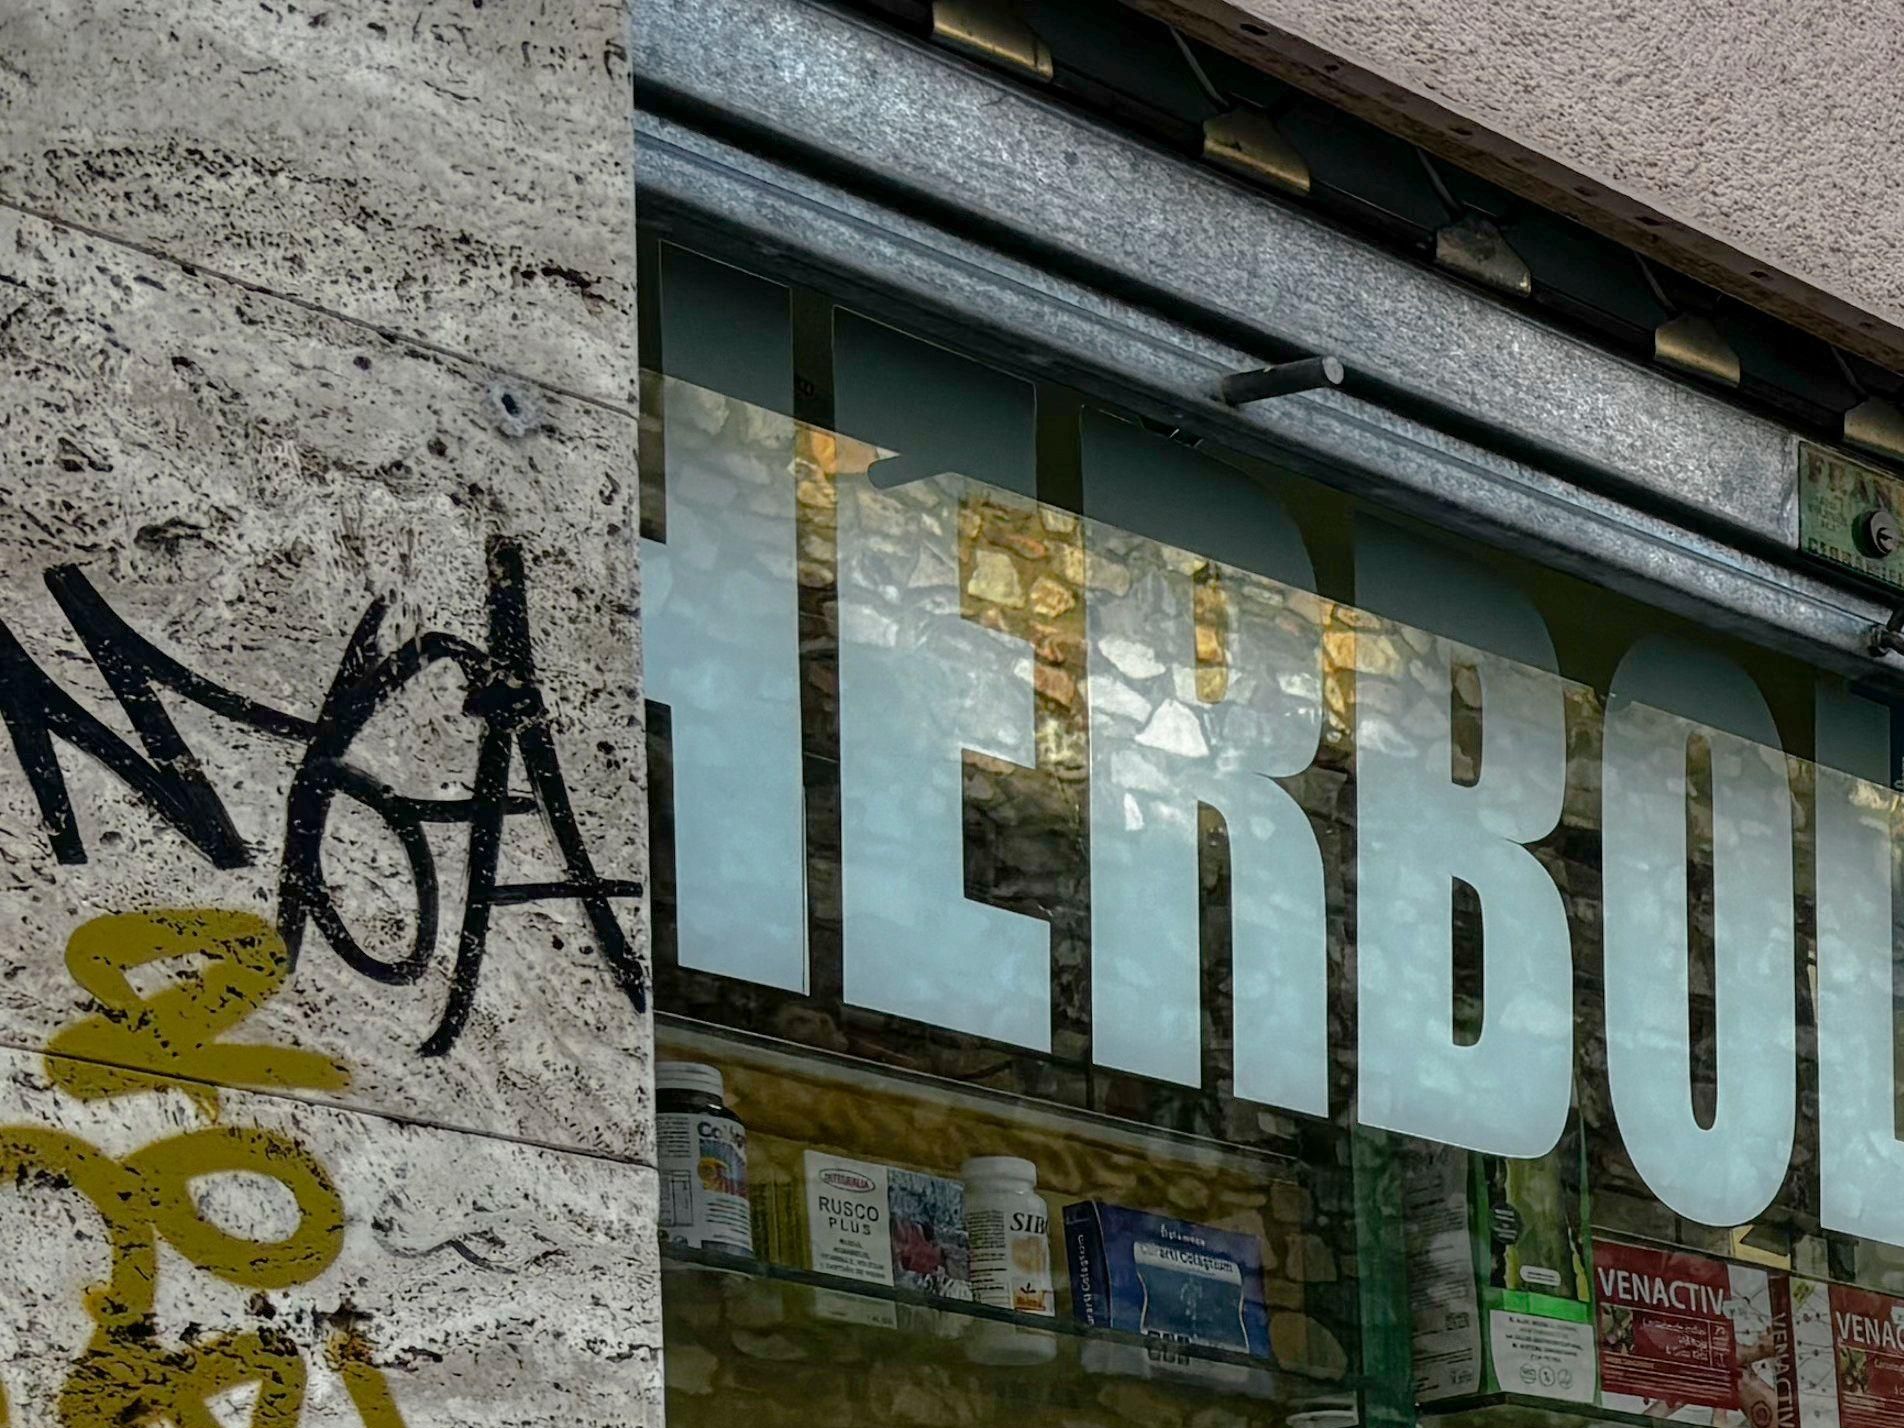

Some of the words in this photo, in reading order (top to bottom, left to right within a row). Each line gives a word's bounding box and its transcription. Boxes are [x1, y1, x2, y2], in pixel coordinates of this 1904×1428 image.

[819, 1195, 879, 1223] RUSCO
[829, 1217, 872, 1237] PLUS
[1597, 1266, 1725, 1317] VENACTIV
[1772, 1311, 1795, 1428] VENACTIV
